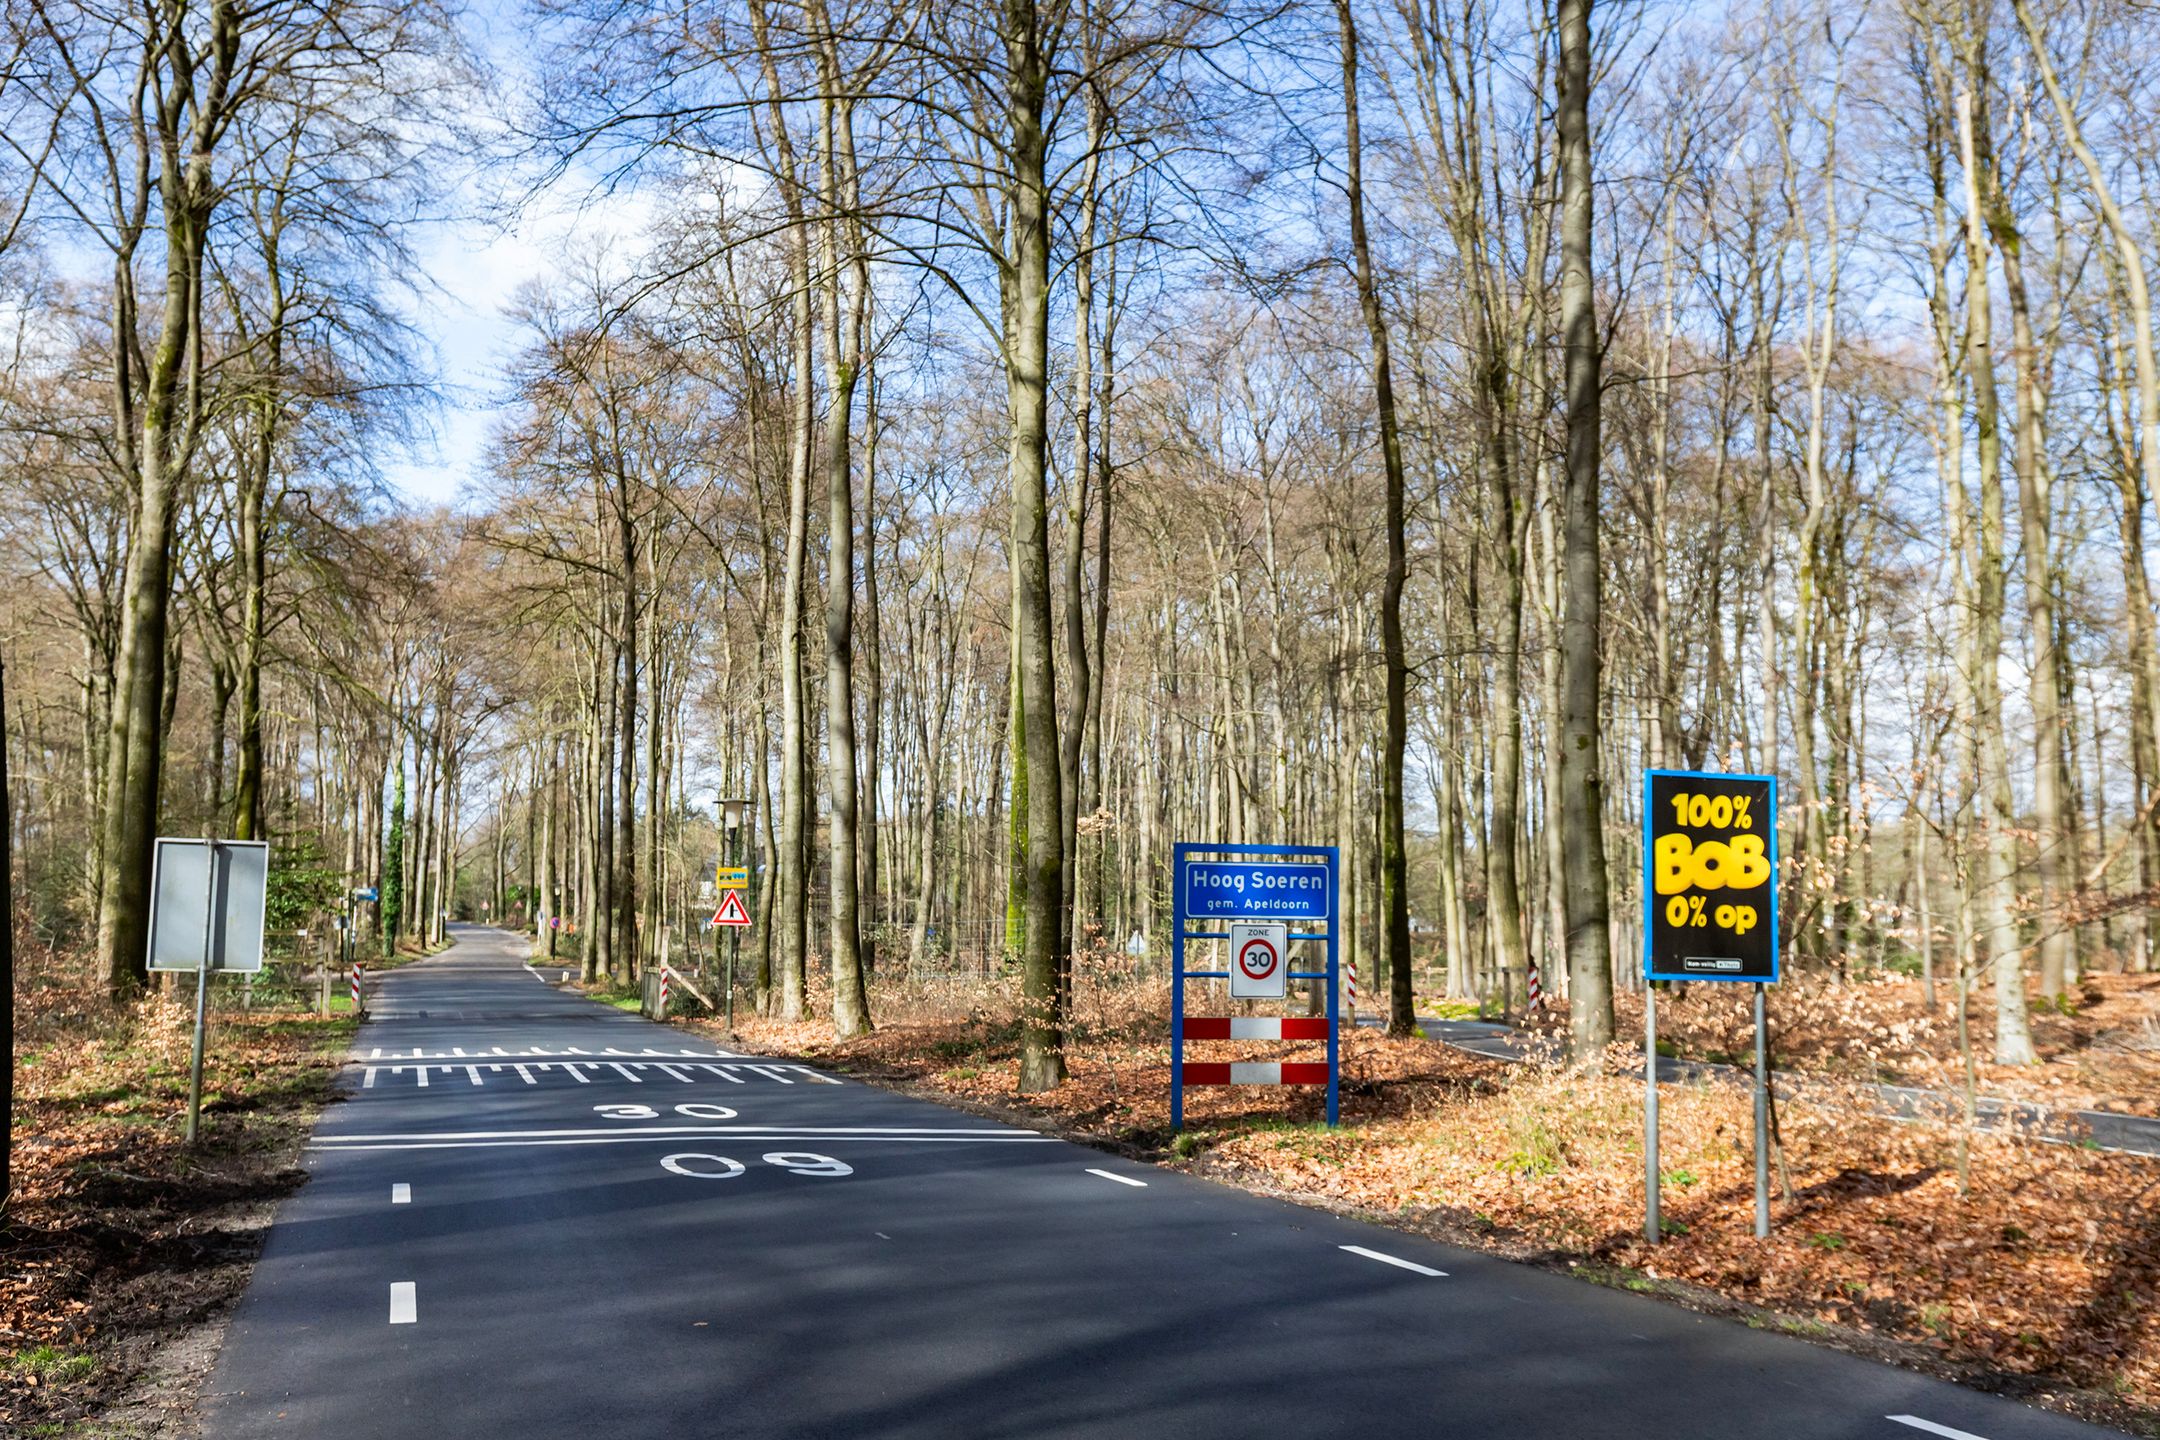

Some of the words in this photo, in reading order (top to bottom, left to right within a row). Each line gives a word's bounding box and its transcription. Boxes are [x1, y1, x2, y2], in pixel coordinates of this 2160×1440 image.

[1671, 793, 1752, 829] 100%
[1655, 833, 1771, 895] BOB
[1193, 870, 1245, 893] Hoog
[1251, 872, 1322, 889] Soeren
[1207, 900, 1238, 910] gem.
[1244, 899, 1310, 910] Apeldoorn
[1666, 895, 1707, 927] 0%
[1714, 904, 1757, 935] op
[1246, 952, 1271, 967] 30
[593, 1104, 738, 1119] 30
